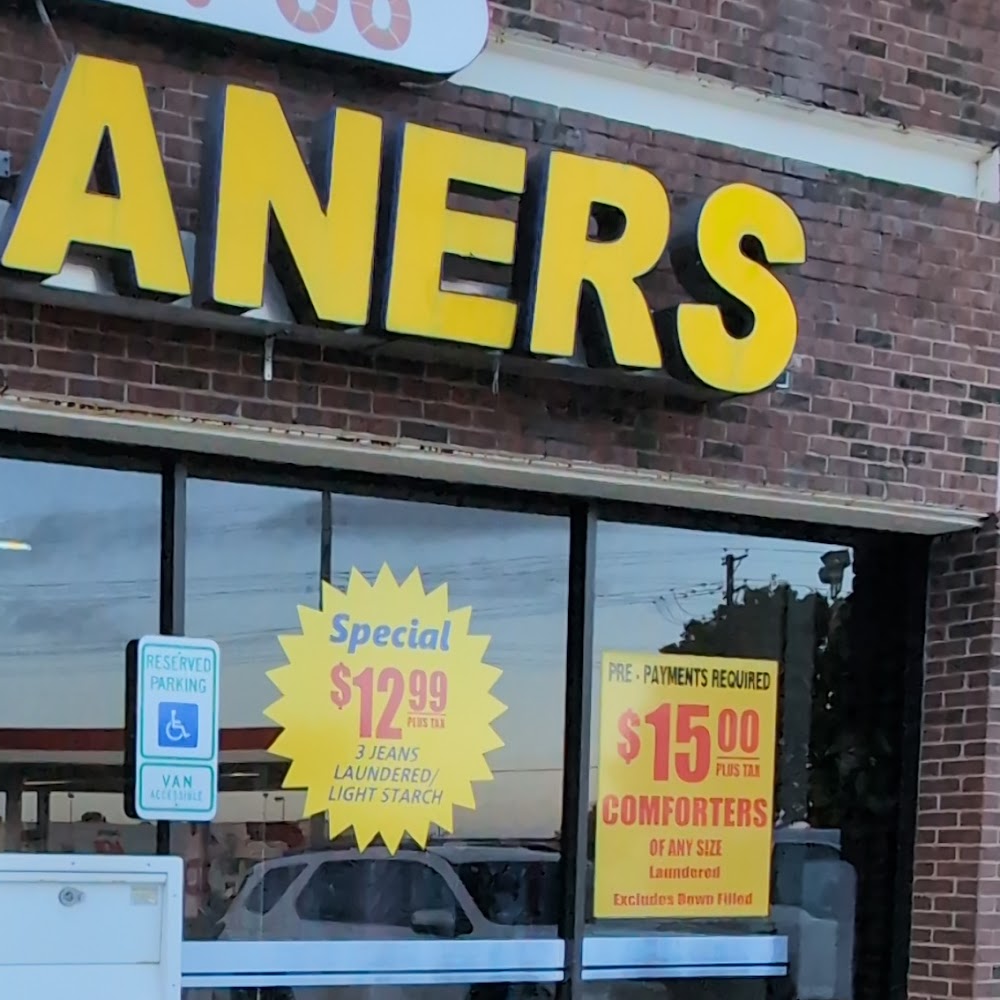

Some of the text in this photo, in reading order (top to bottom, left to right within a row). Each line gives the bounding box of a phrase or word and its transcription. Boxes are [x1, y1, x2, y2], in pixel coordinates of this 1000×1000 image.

[329, 612, 452, 654] Special
[147, 654, 212, 673] RESERVED
[150, 675, 207, 694] PARKING
[608, 662, 633, 682] PRE
[643, 664, 708, 687] PAYMENTS
[711, 668, 771, 690] REQUIRED
[407, 716, 429, 729] PLUS
[355, 744, 420, 762] 3 JEANS
[716, 762, 761, 778] PLUS TAX
[162, 773, 193, 789] VAN
[328, 785, 444, 805] LIGHT STARCH
[602, 794, 768, 828] COMFORTERS
[649, 838, 723, 857] OF ANY SIZE
[649, 865, 721, 880] Laundered
[613, 892, 753, 907] Excludes Down Filled
